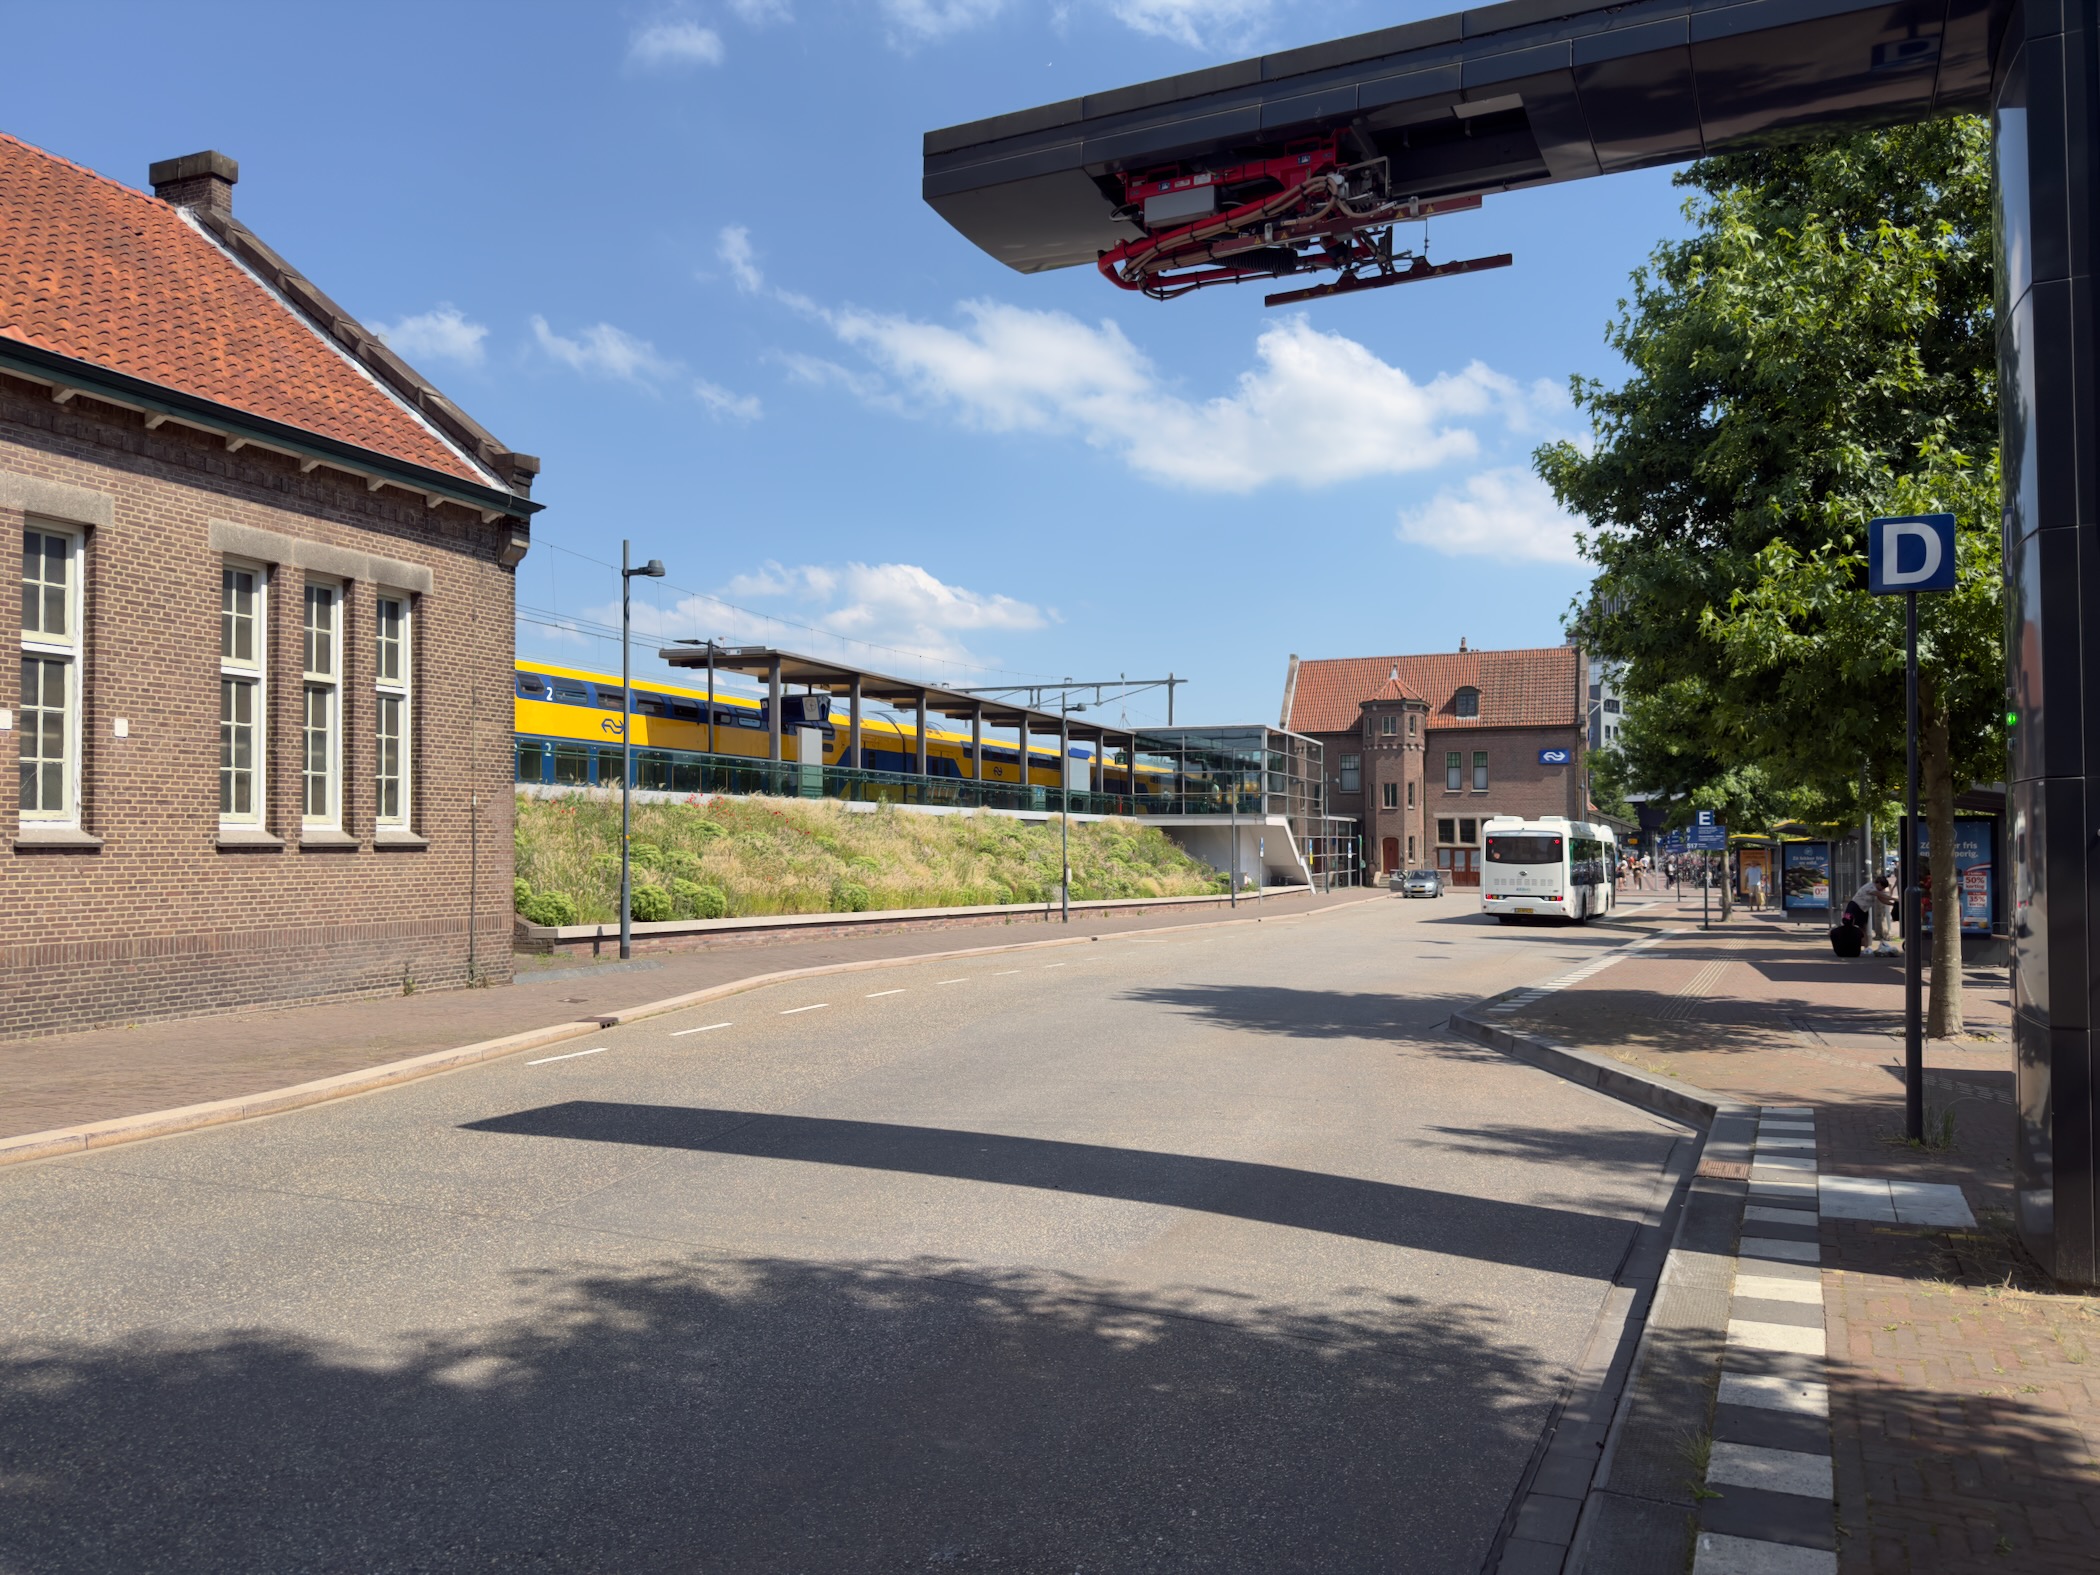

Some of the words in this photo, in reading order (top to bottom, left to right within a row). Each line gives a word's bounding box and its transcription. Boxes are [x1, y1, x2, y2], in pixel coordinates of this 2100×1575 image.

[1883, 522, 1942, 585] D
[546, 687, 553, 701] 2
[545, 742, 552, 756] 2
[1699, 812, 1711, 825] E
